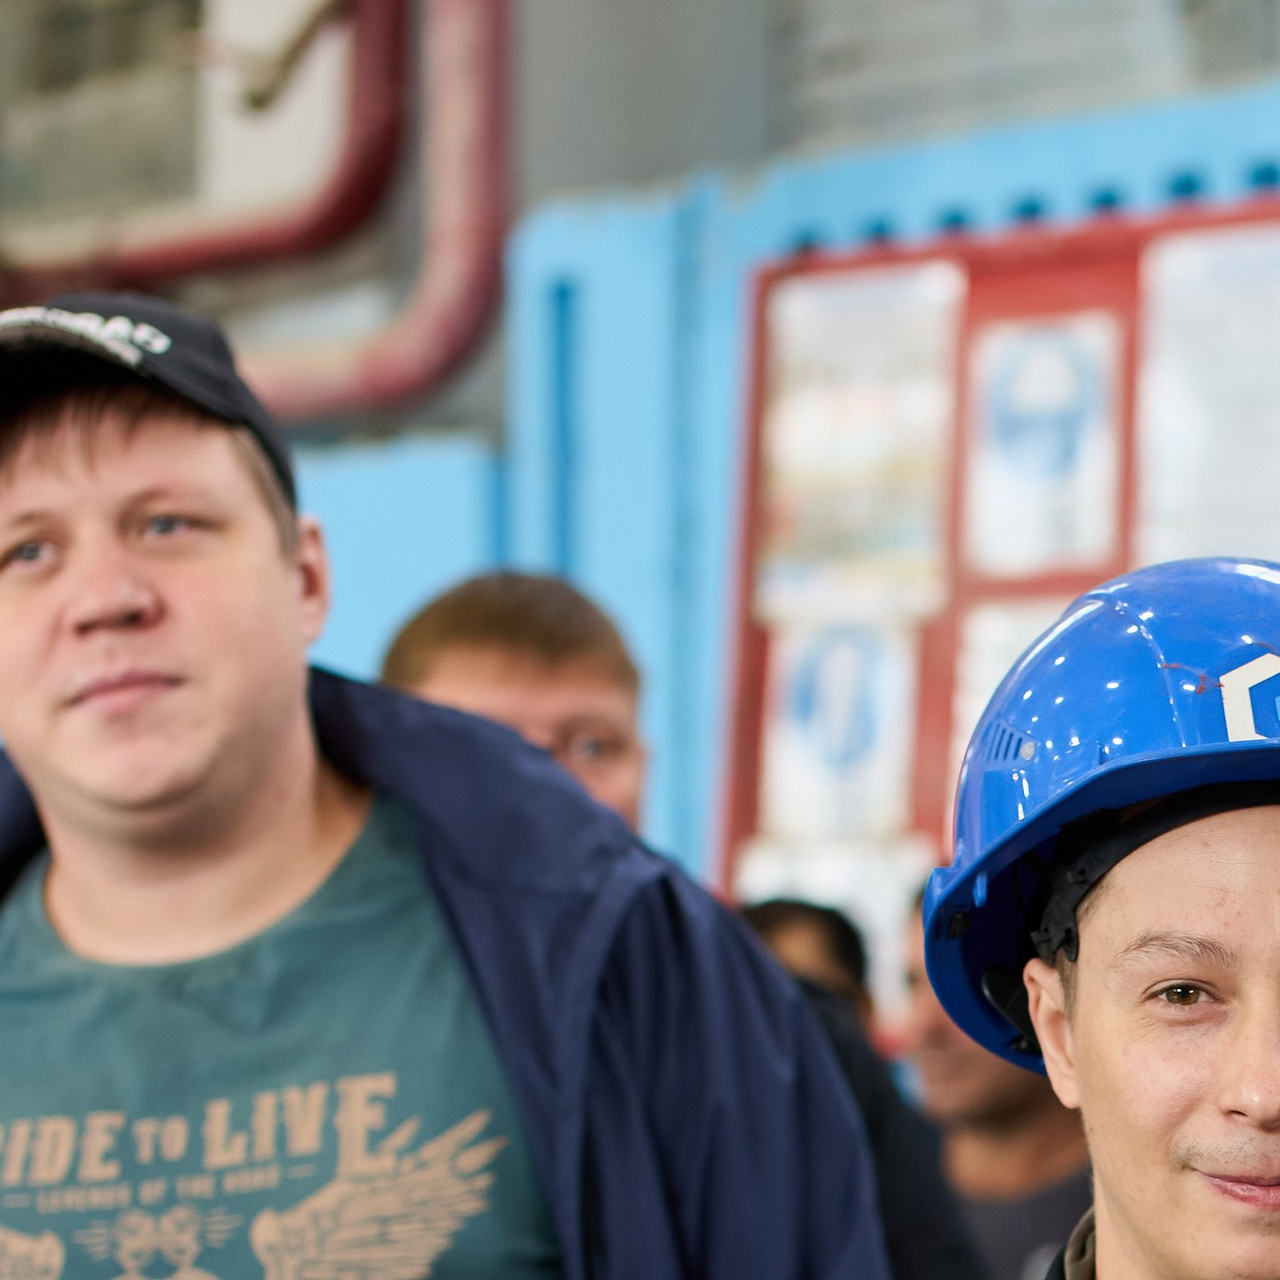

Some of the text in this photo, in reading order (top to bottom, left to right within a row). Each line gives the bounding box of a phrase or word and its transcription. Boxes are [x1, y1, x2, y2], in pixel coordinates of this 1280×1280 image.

[0, 1072, 396, 1186] IDE TO LIVE
